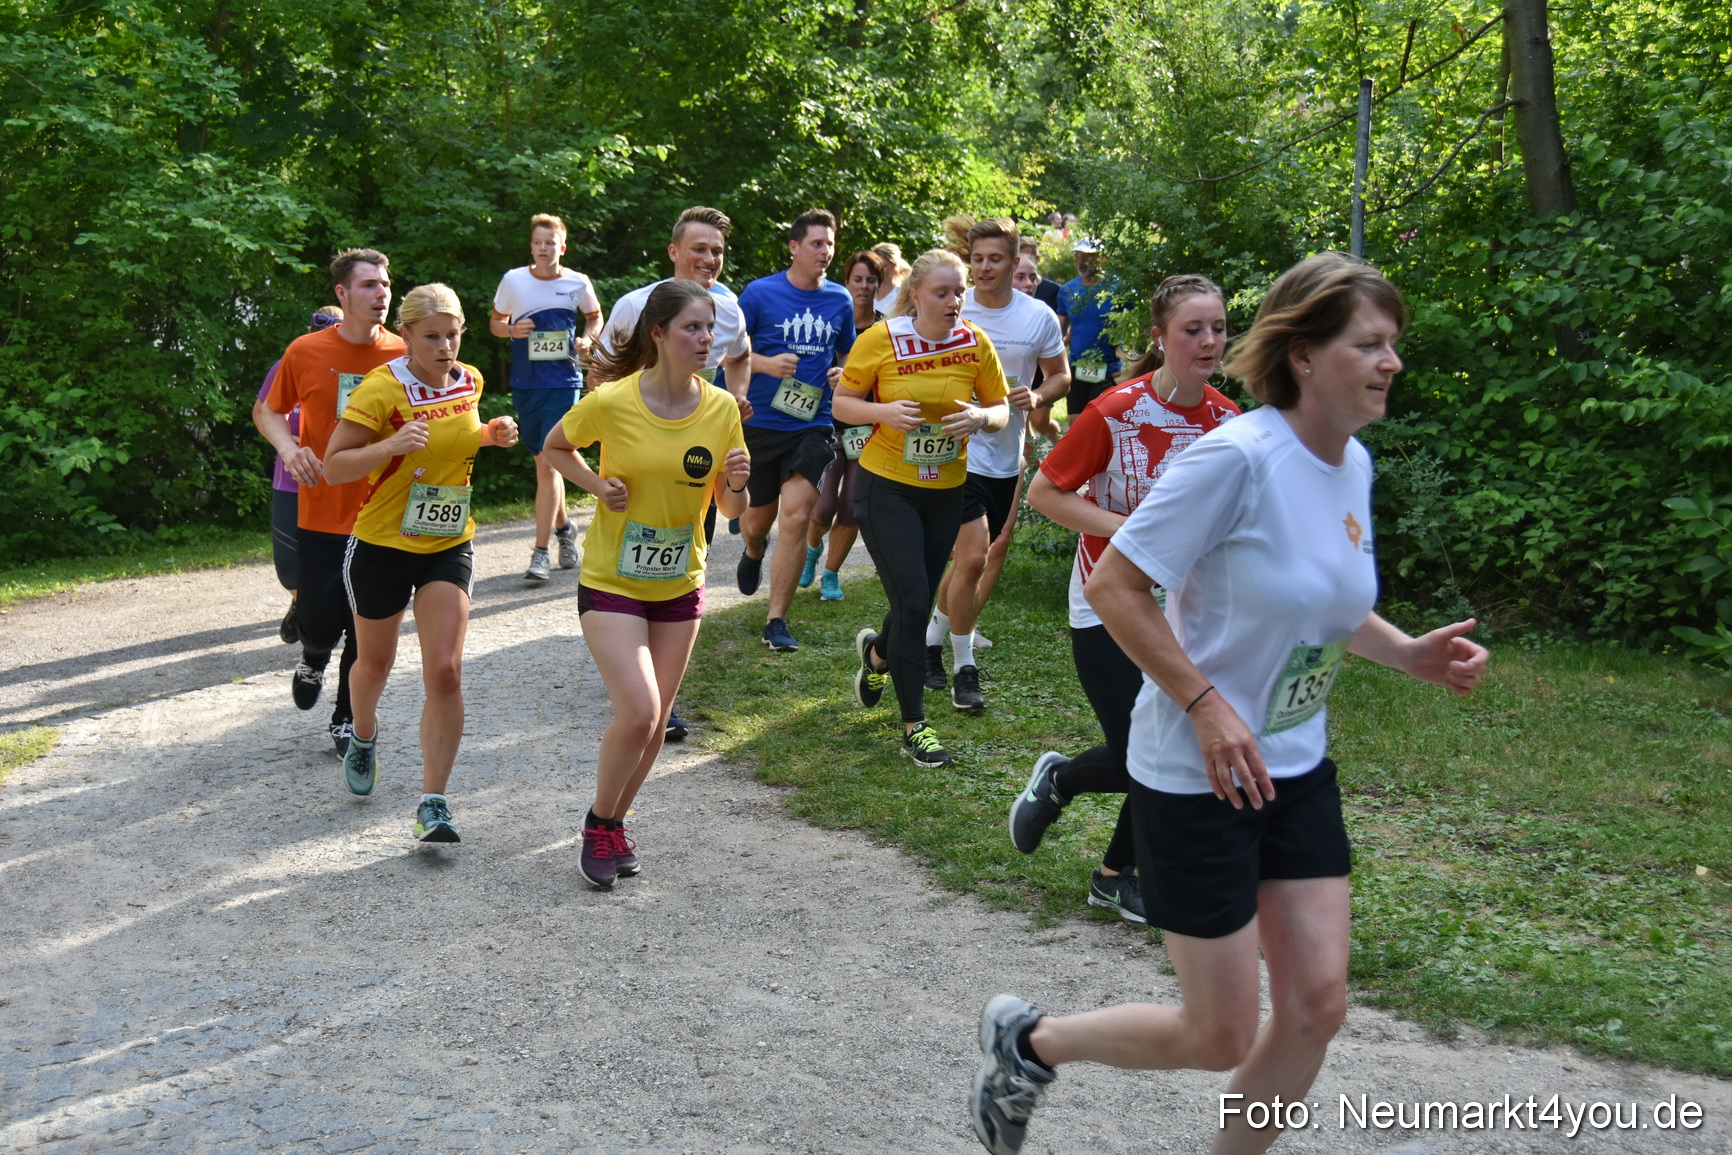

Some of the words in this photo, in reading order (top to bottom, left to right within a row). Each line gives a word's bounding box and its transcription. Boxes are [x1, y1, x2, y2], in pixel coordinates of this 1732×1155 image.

[534, 341, 564, 352] 2424
[787, 344, 825, 353] GEMEINSAM
[897, 360, 936, 376] MAX
[941, 352, 980, 367] BÖGL
[413, 408, 449, 420] MAX
[452, 399, 477, 415] BÖG
[783, 390, 815, 411] 1714
[912, 435, 955, 454] 1675
[686, 454, 703, 465] NM
[416, 502, 462, 522] 1589
[632, 543, 685, 566] 1767
[636, 564, 662, 572] Pröpster
